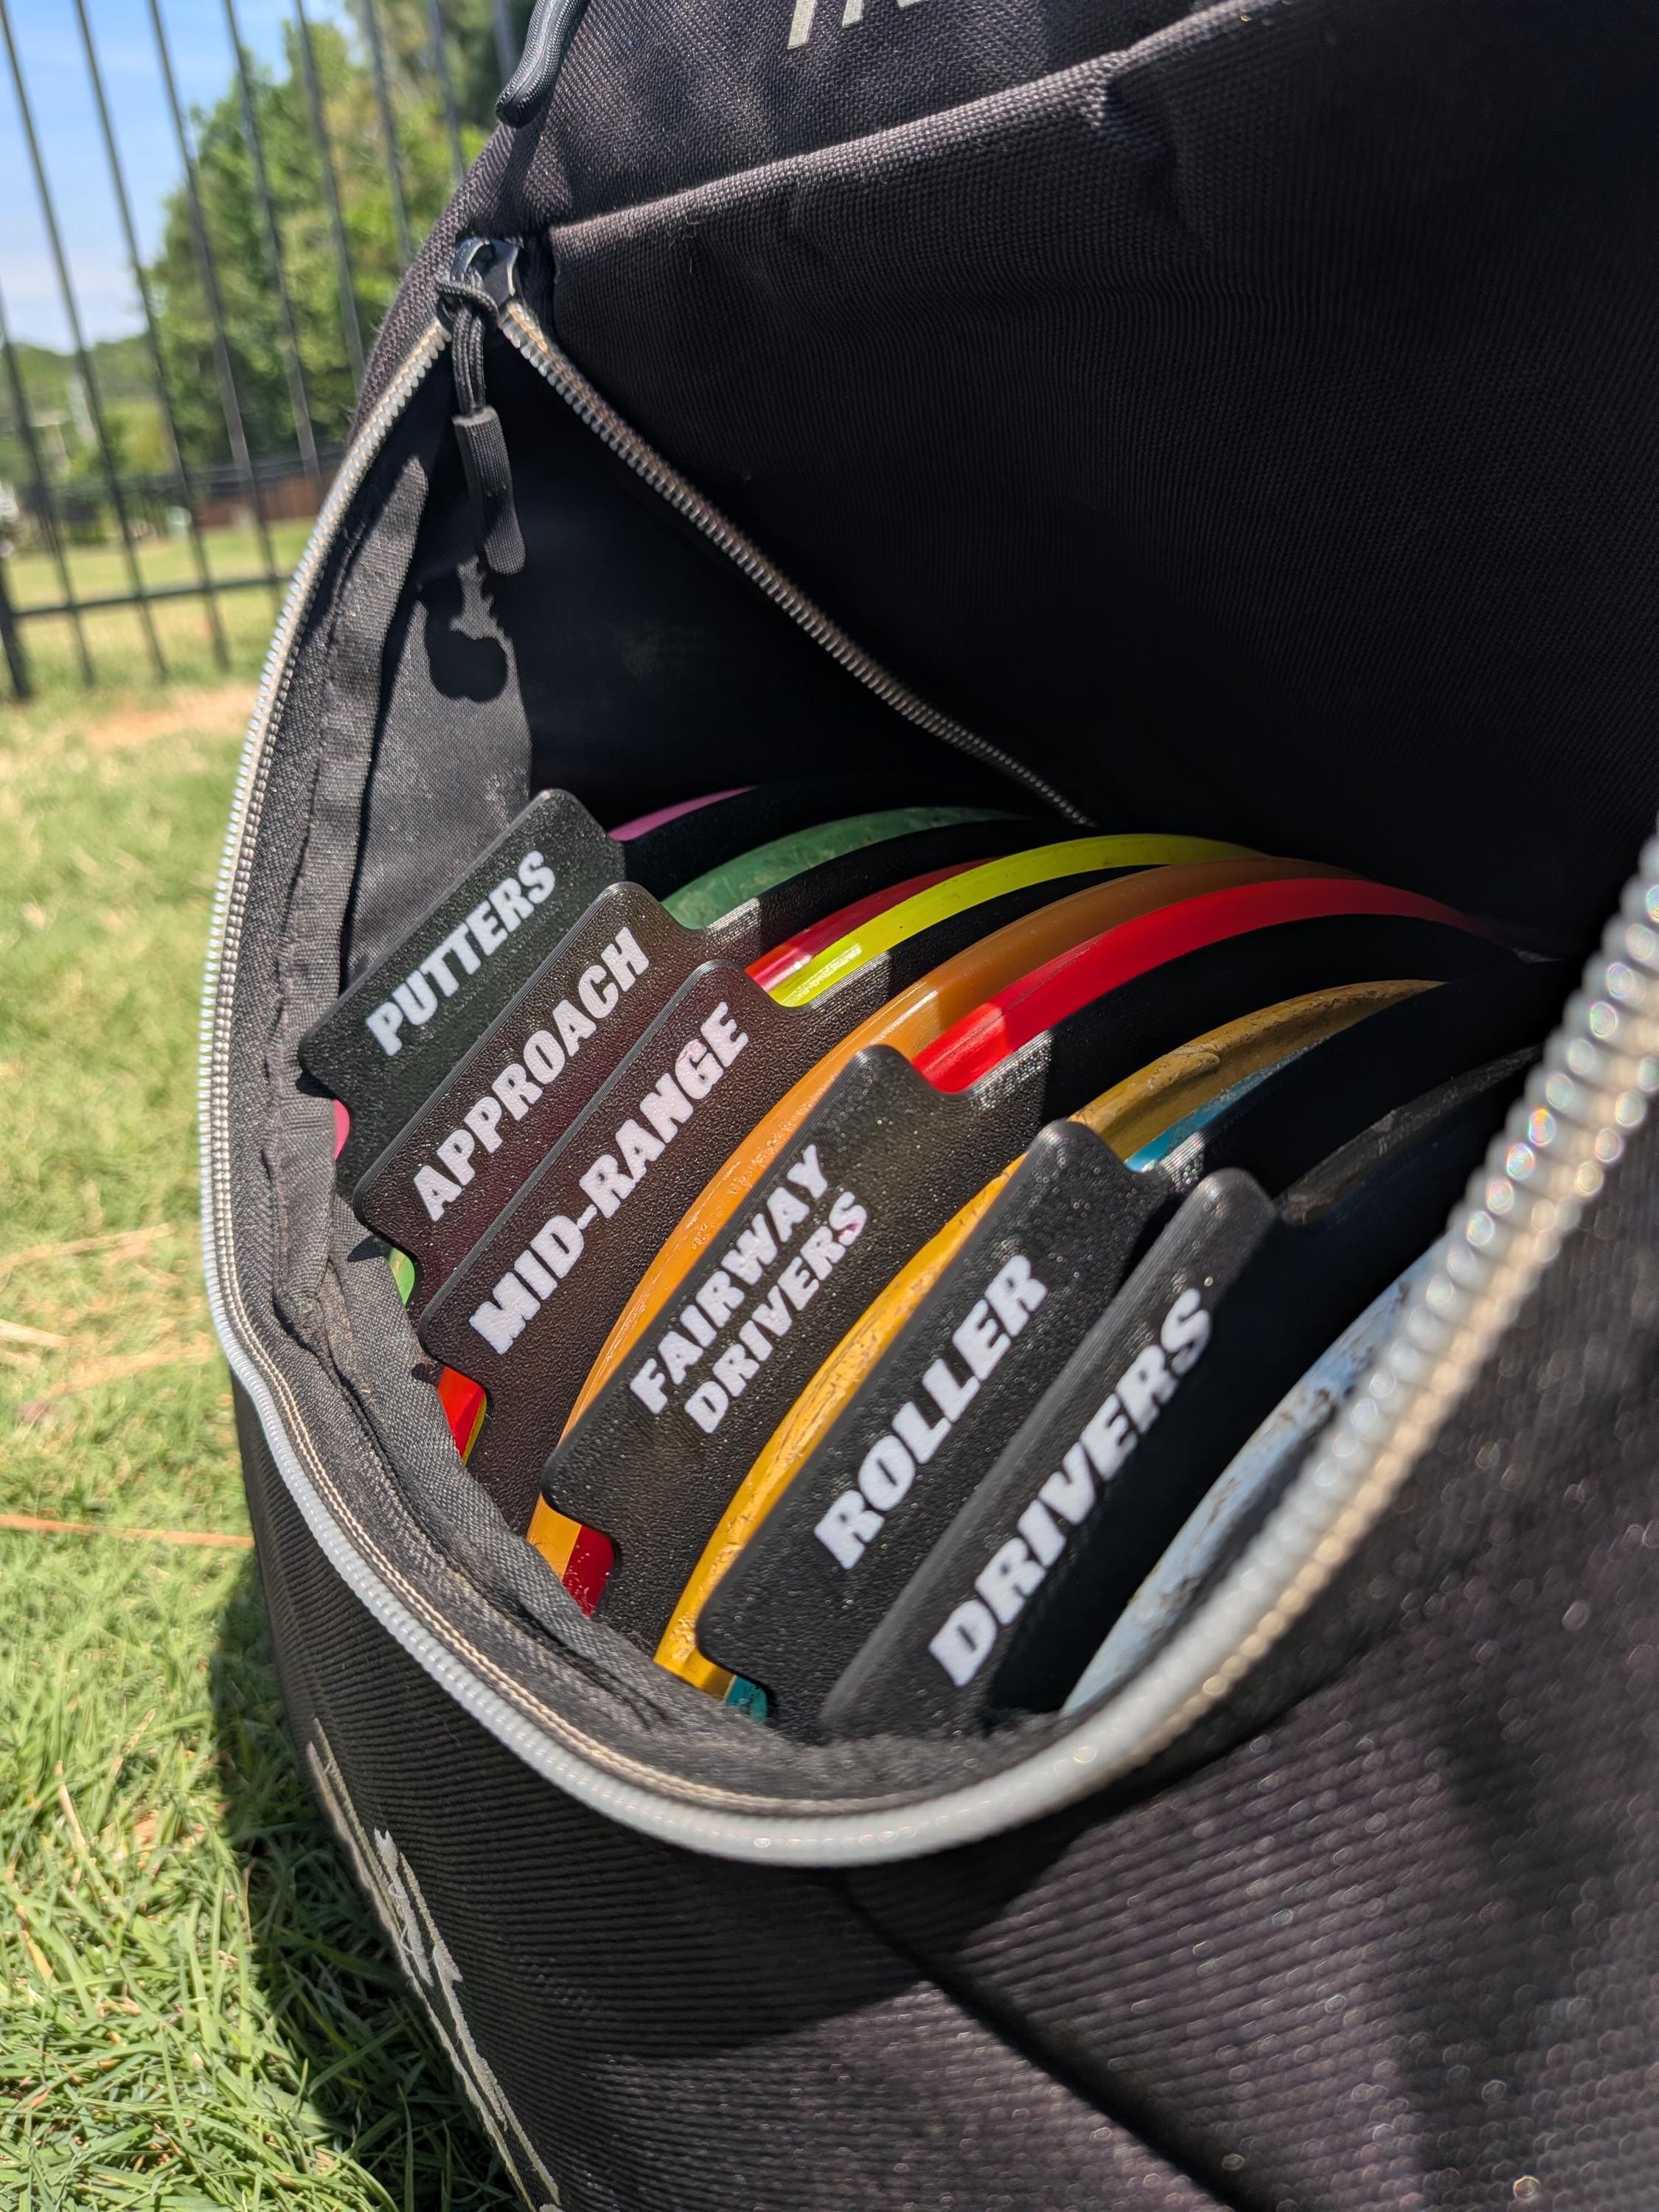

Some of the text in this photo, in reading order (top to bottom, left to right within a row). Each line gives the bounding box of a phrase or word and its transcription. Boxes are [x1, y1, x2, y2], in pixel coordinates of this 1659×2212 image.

[366, 850, 556, 1056] PUTTERS
[413, 927, 650, 1222] APPROACH
[470, 1001, 748, 1354] MID-RANGE
[630, 1144, 830, 1414] FAIRWAY
[684, 1191, 869, 1433] DRIVERS
[814, 1254, 1048, 1570] ROLLER
[928, 1288, 1213, 1686] DRIVERS
